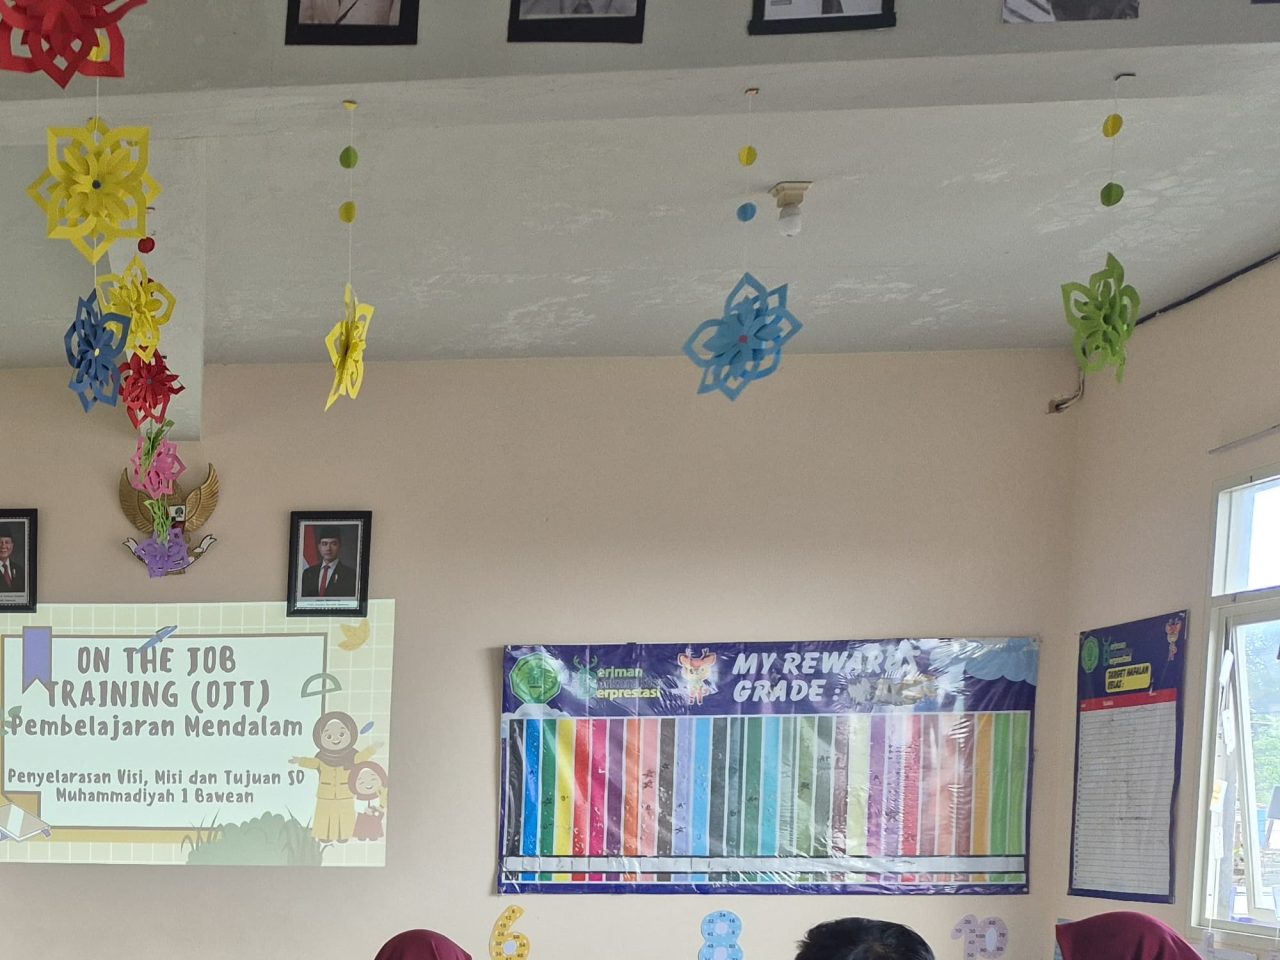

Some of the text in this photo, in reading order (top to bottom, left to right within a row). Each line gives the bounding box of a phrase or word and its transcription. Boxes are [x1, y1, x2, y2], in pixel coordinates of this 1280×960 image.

[77, 645, 236, 676] ON THE JOB
[732, 652, 777, 675] MY
[46, 679, 270, 713] TRAINING (OJT)
[733, 680, 827, 703] GRADE
[10, 714, 303, 741] Pembelajaran Mendalam
[8, 768, 305, 788] Penyelarasan Visi, Misi dan Tujuan SD
[56, 787, 254, 806] Muhammadiyah 1 Bawean
